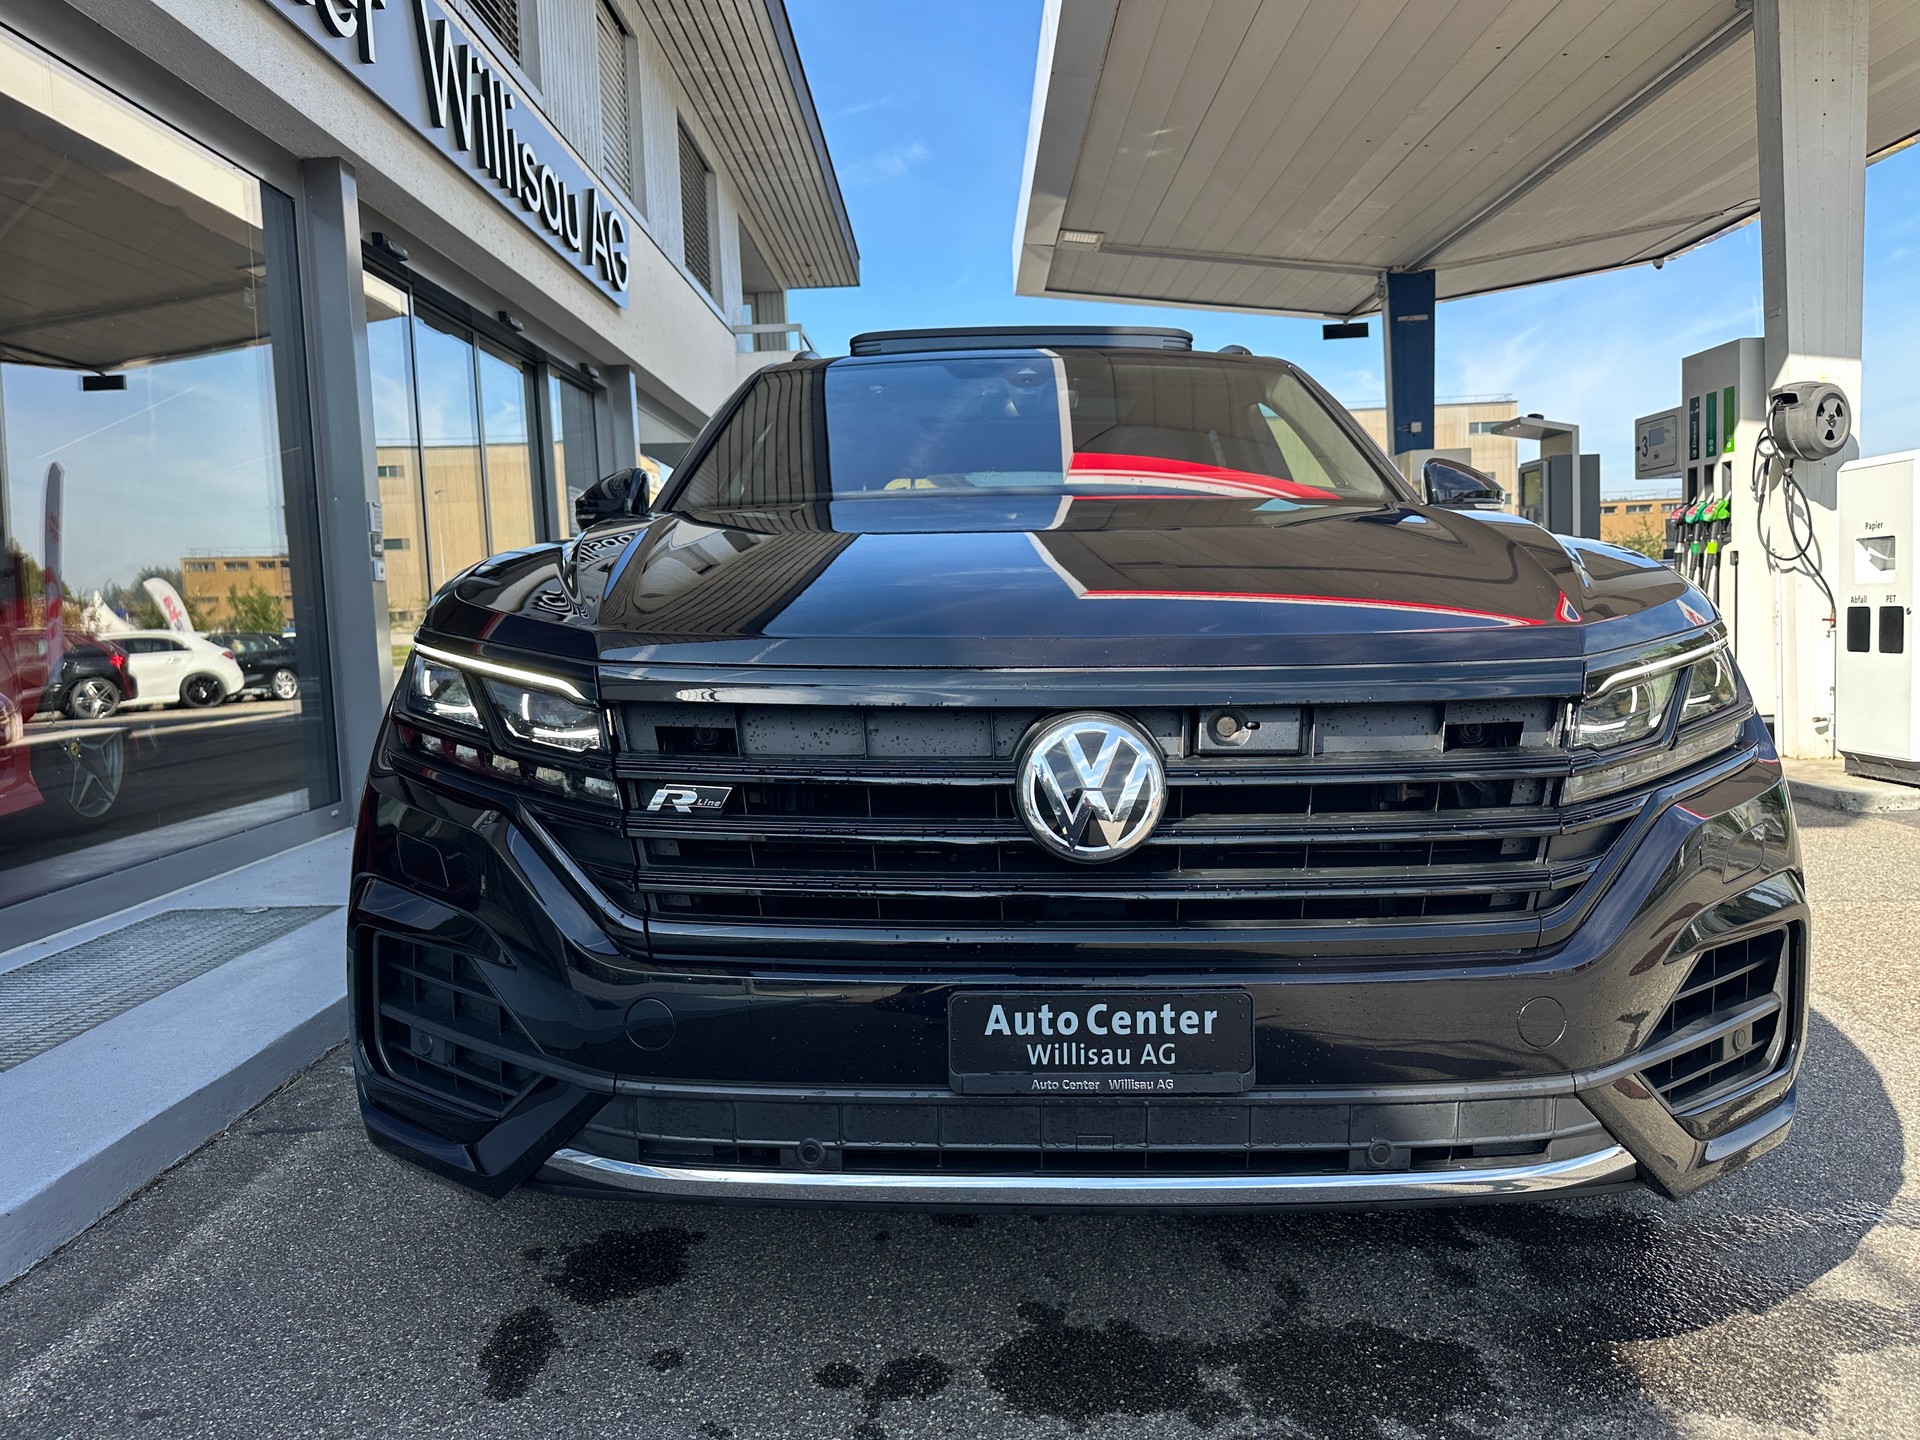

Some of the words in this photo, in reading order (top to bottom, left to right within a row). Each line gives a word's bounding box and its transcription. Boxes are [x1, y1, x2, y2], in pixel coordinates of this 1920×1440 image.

[412, 0, 582, 252] Willisau
[586, 188, 630, 292] AG
[1641, 436, 1649, 457] 3
[1864, 521, 1884, 532] Papier
[1850, 595, 1868, 604] Abfall
[1885, 594, 1897, 603] PET
[646, 788, 698, 813] R
[984, 1003, 1079, 1035] Auto
[1086, 1002, 1218, 1035] Center
[1026, 1042, 1131, 1065] Willisau
[1140, 1043, 1176, 1065] AG
[1031, 1079, 1060, 1090] Auto
[1061, 1079, 1100, 1090] Center
[1108, 1079, 1154, 1090] Willisau
[1156, 1079, 1174, 1090] AG
